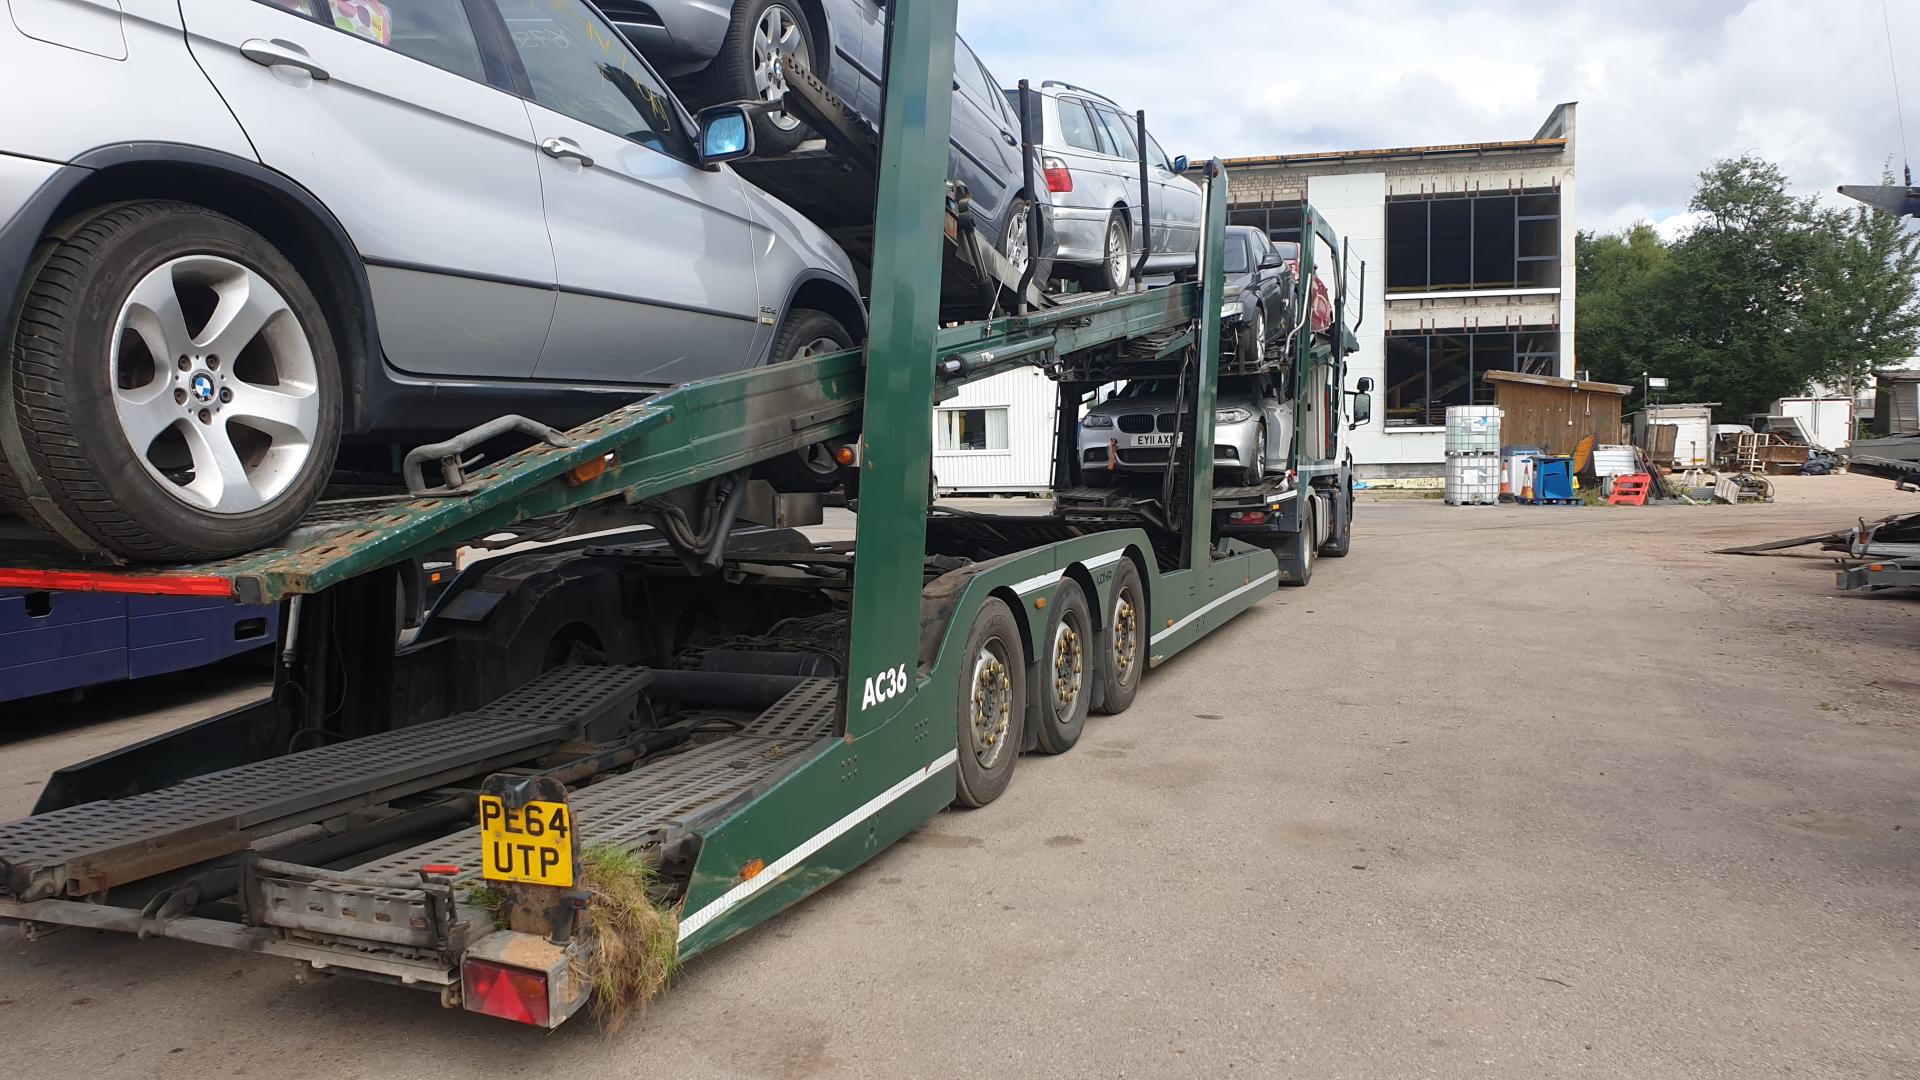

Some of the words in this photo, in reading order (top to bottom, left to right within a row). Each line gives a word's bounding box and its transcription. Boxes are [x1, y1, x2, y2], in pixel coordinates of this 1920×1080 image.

[1137, 435, 1155, 445] EY11
[861, 662, 908, 711] AC36
[481, 799, 569, 839] PE64
[493, 841, 560, 878] UTP
